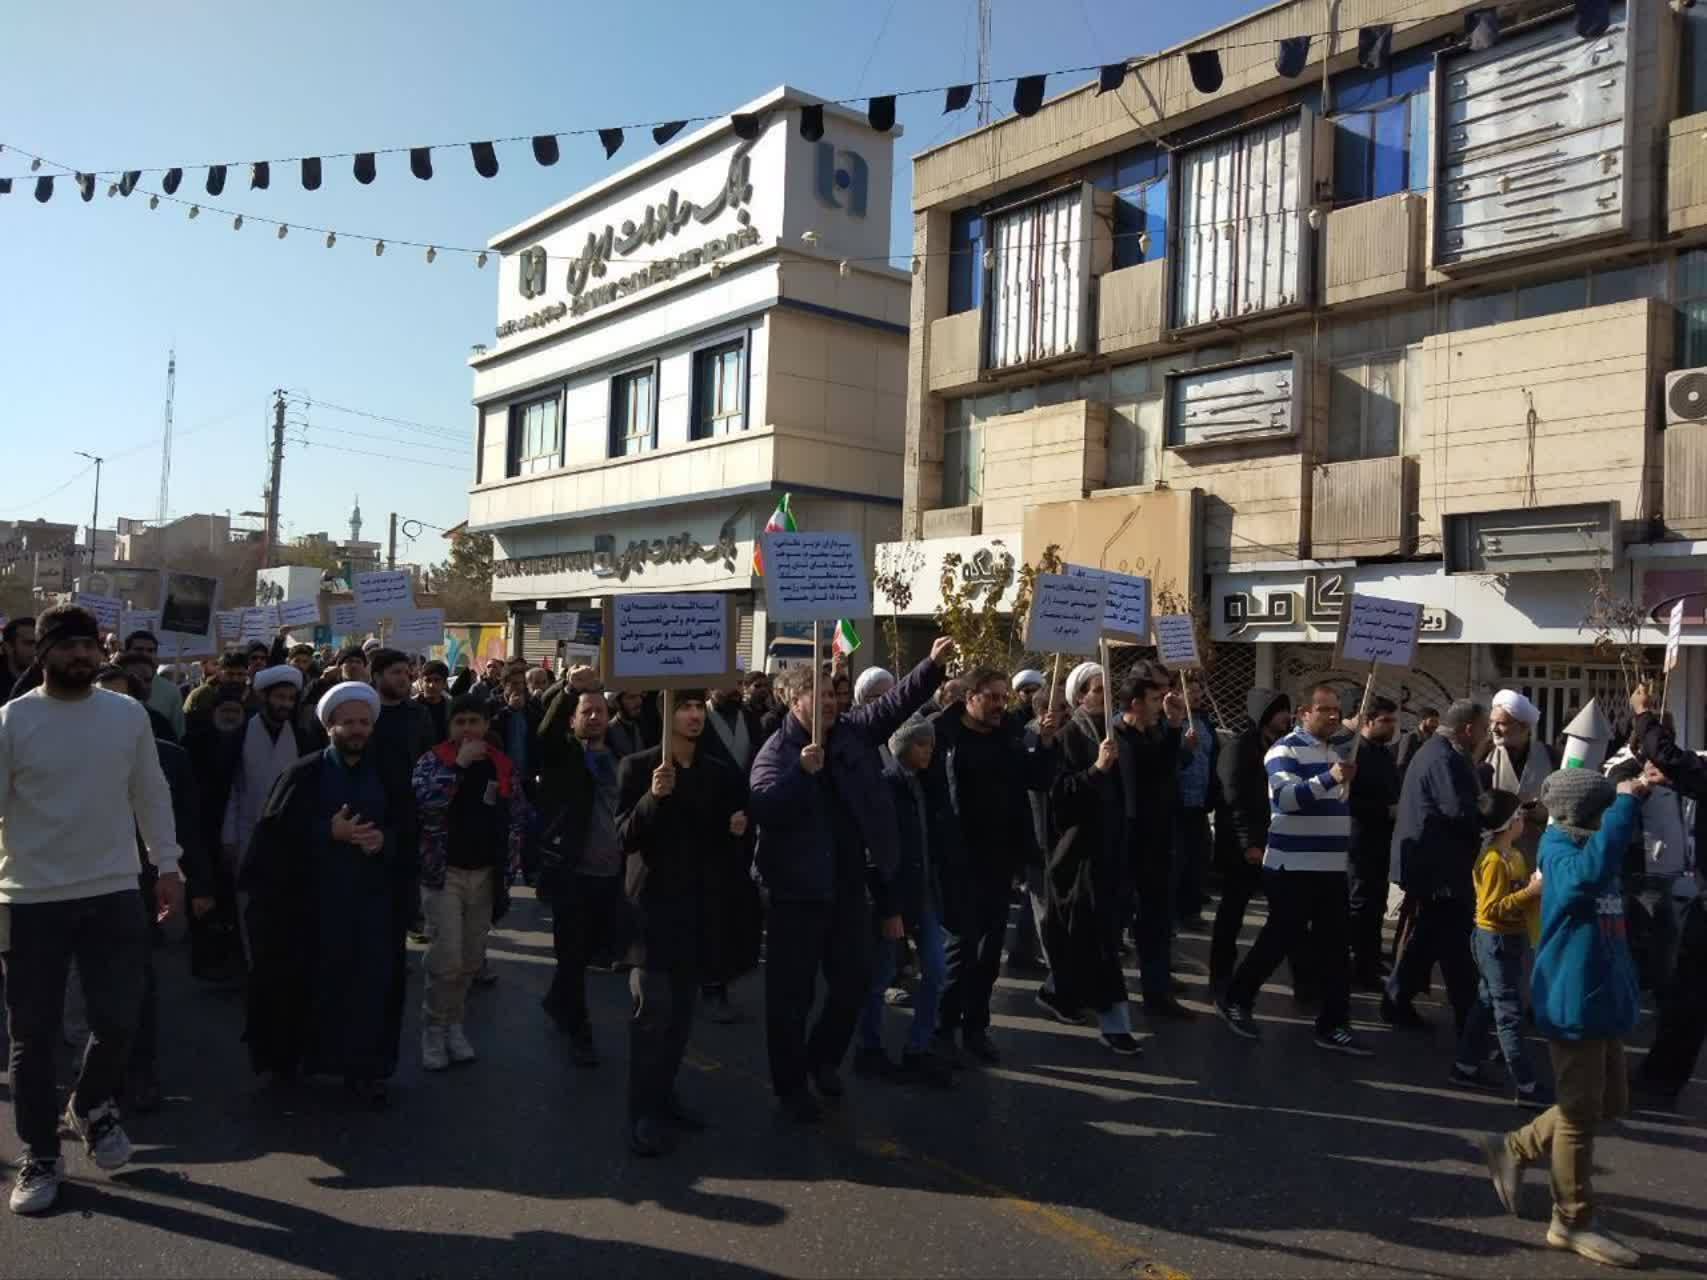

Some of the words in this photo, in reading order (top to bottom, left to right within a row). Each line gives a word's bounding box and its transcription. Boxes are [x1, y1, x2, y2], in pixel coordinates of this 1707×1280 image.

[691, 121, 770, 224] بانک
[566, 225, 614, 298] ایران
[701, 512, 746, 575] بانک
[685, 617, 721, 627] مردم
